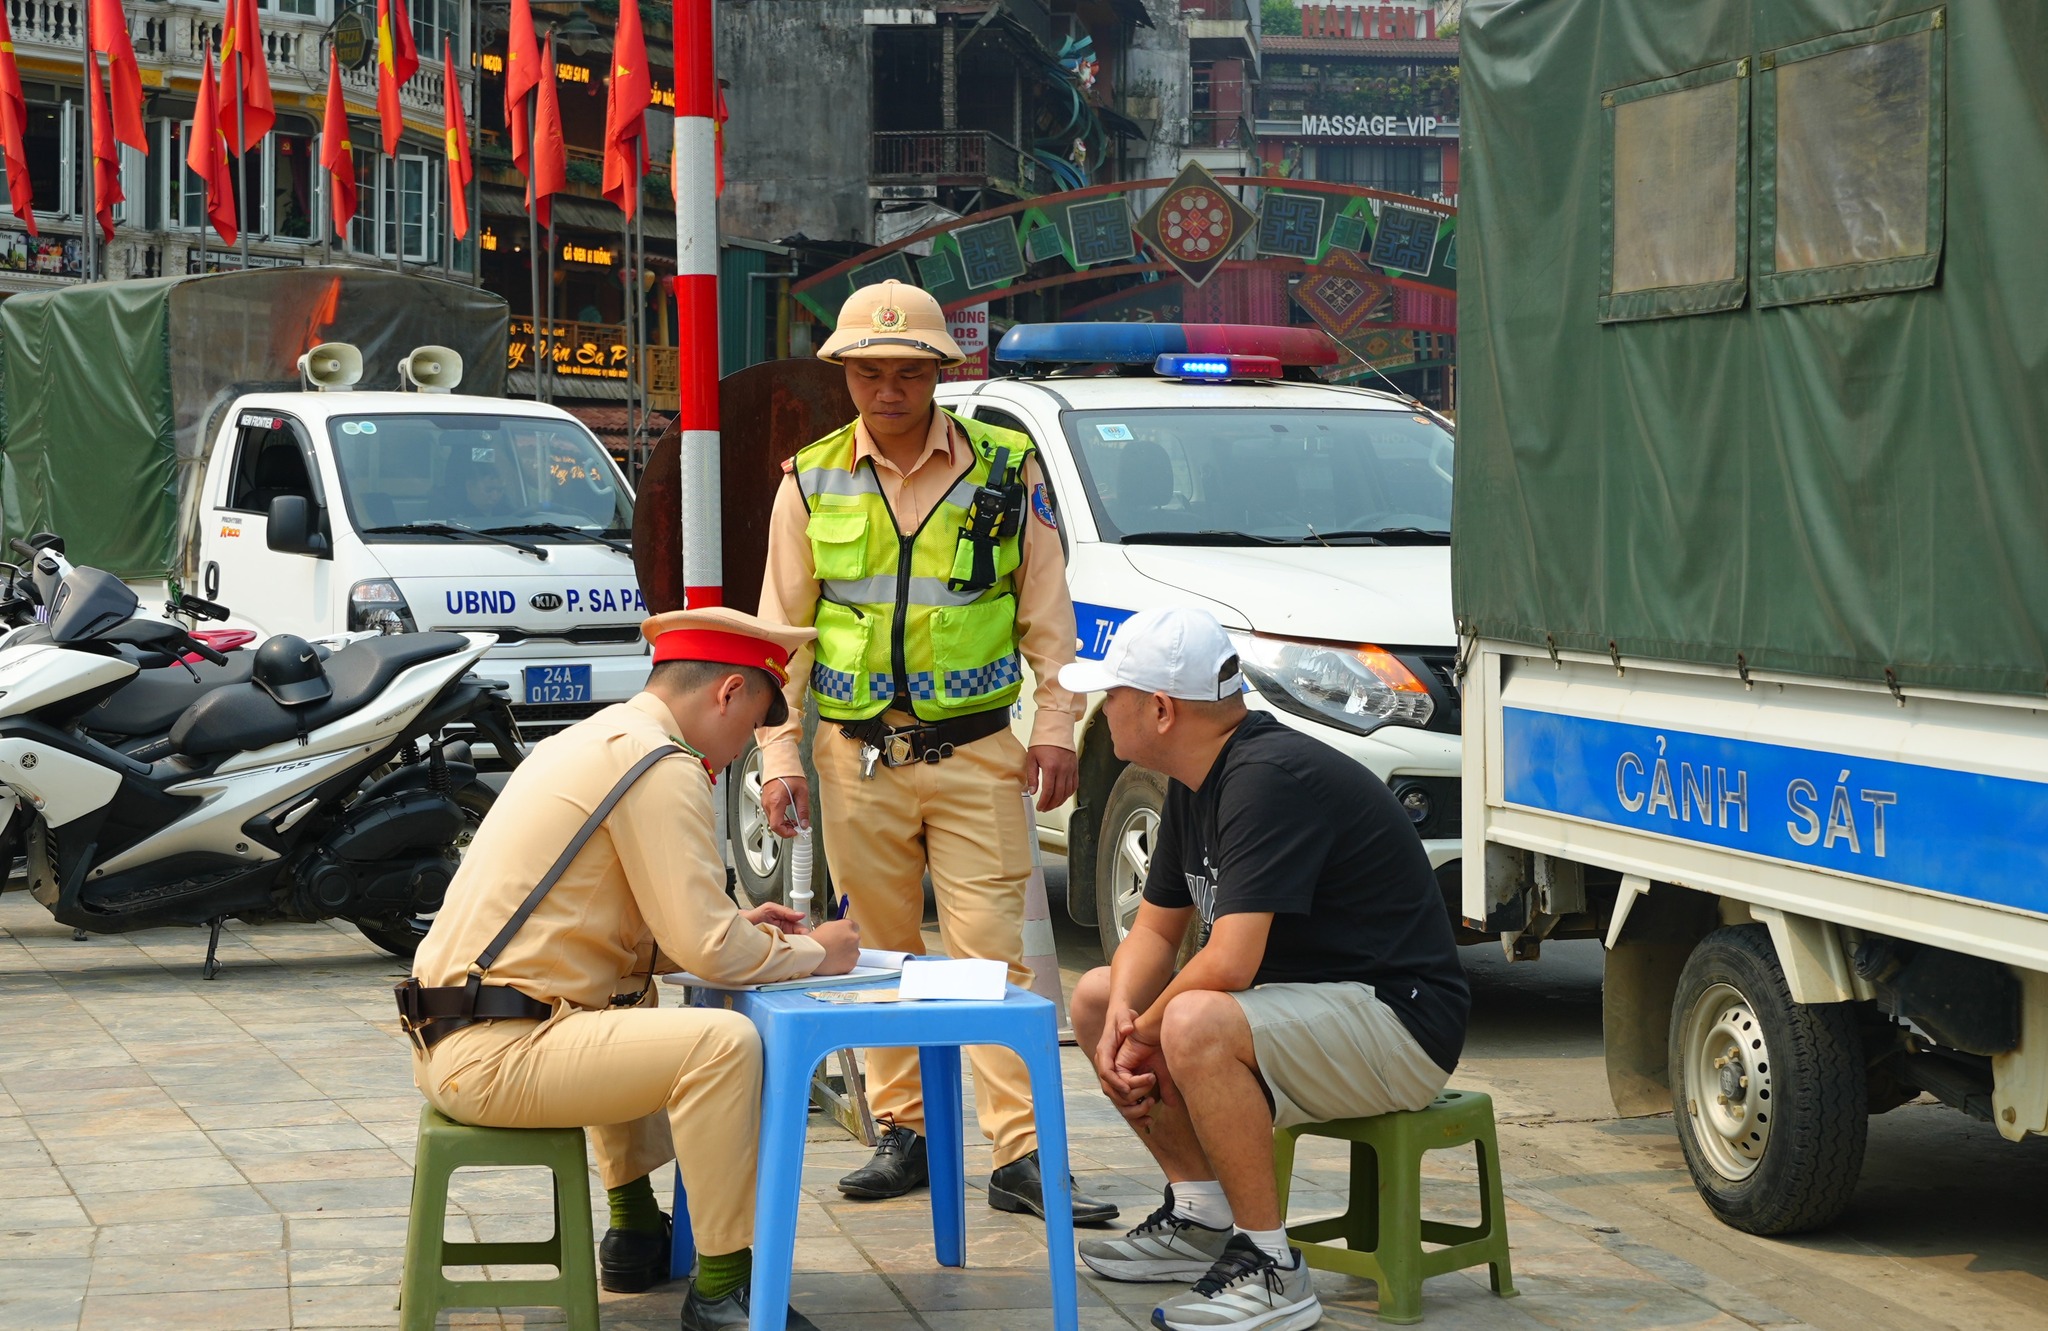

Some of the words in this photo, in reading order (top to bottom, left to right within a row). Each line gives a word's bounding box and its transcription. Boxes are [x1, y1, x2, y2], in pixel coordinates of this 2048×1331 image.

[1302, 115, 1397, 136] MASSAGE
[1406, 115, 1437, 137] VIP
[0, 232, 13, 240] ine
[196, 250, 213, 260] Sak
[953, 328, 978, 339] 08
[576, 342, 604, 366] Sa
[611, 344, 635, 367] P
[446, 590, 516, 614] UBND
[566, 589, 583, 613] P.
[588, 588, 617, 612] SA
[620, 589, 647, 612] PA
[535, 595, 560, 608] KIA
[544, 667, 573, 684] 24A
[532, 684, 584, 702] 012.37
[274, 761, 311, 774] 155
[1615, 735, 1748, 832] CẢNH
[1786, 769, 1897, 858] SÁT
